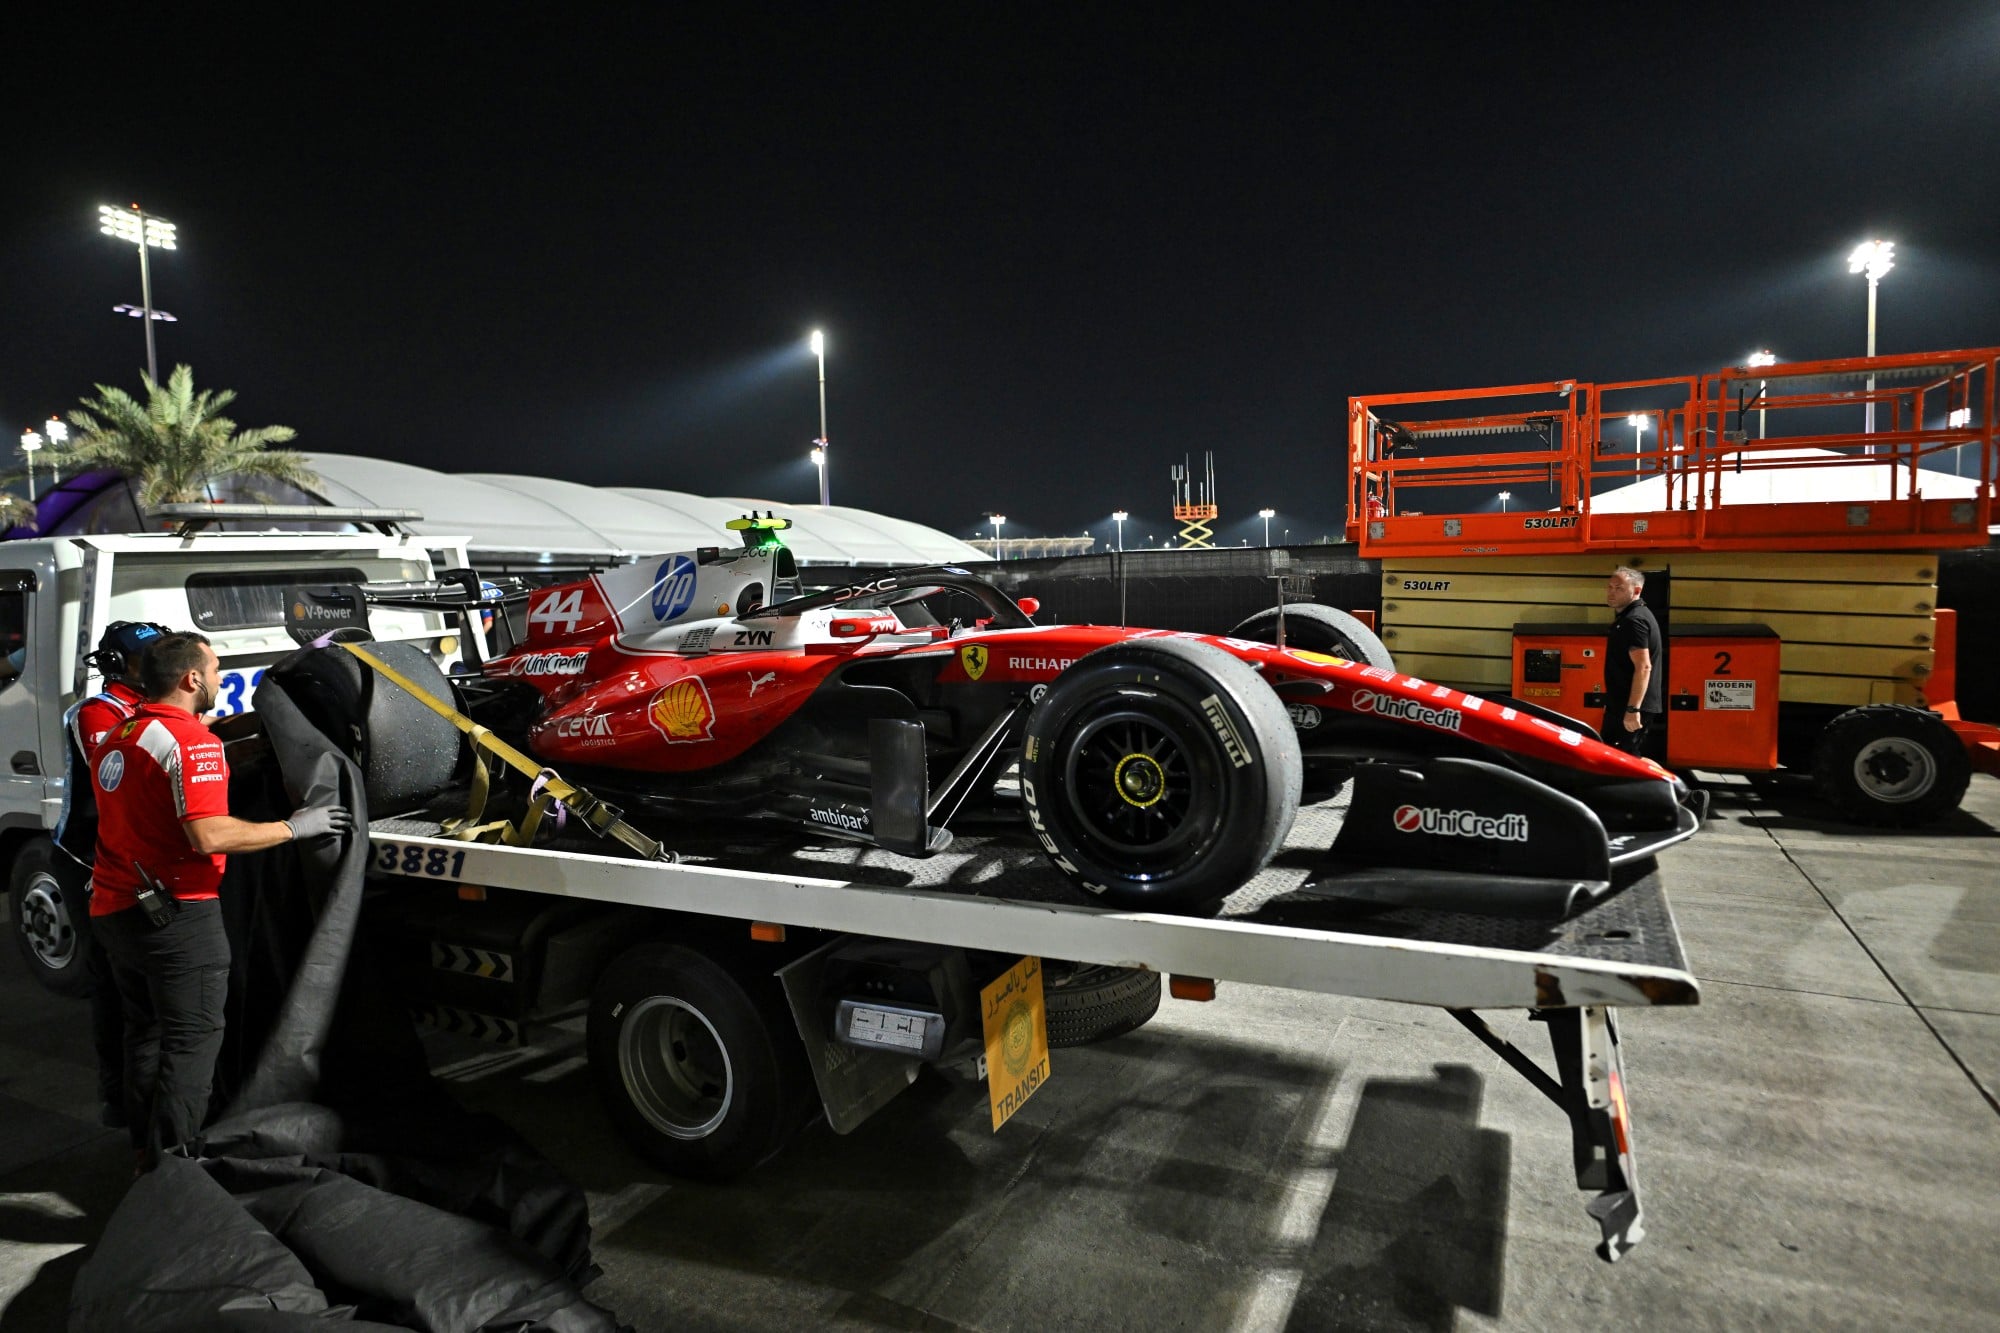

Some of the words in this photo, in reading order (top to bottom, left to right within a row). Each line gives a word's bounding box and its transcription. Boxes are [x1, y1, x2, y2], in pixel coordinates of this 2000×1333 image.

[1525, 516, 1578, 528] 530LRT
[653, 556, 691, 621] hp
[1403, 580, 1450, 591] 530LRT
[305, 606, 351, 620] V-Power
[529, 590, 584, 634] 44
[733, 631, 773, 646] ZYN
[870, 621, 896, 633] ZYN
[524, 653, 589, 676] UniCredit
[1009, 657, 1079, 670] RICHAR
[1713, 651, 1731, 675] 2
[1374, 694, 1461, 731] UniCredit
[581, 738, 616, 747] LOGISTICS
[1201, 694, 1253, 768] PIRELLI
[100, 750, 122, 792] hp
[1023, 778, 1080, 876] ZERO
[1421, 808, 1528, 841] UniCredit
[996, 1059, 1047, 1122] TRANSIT
